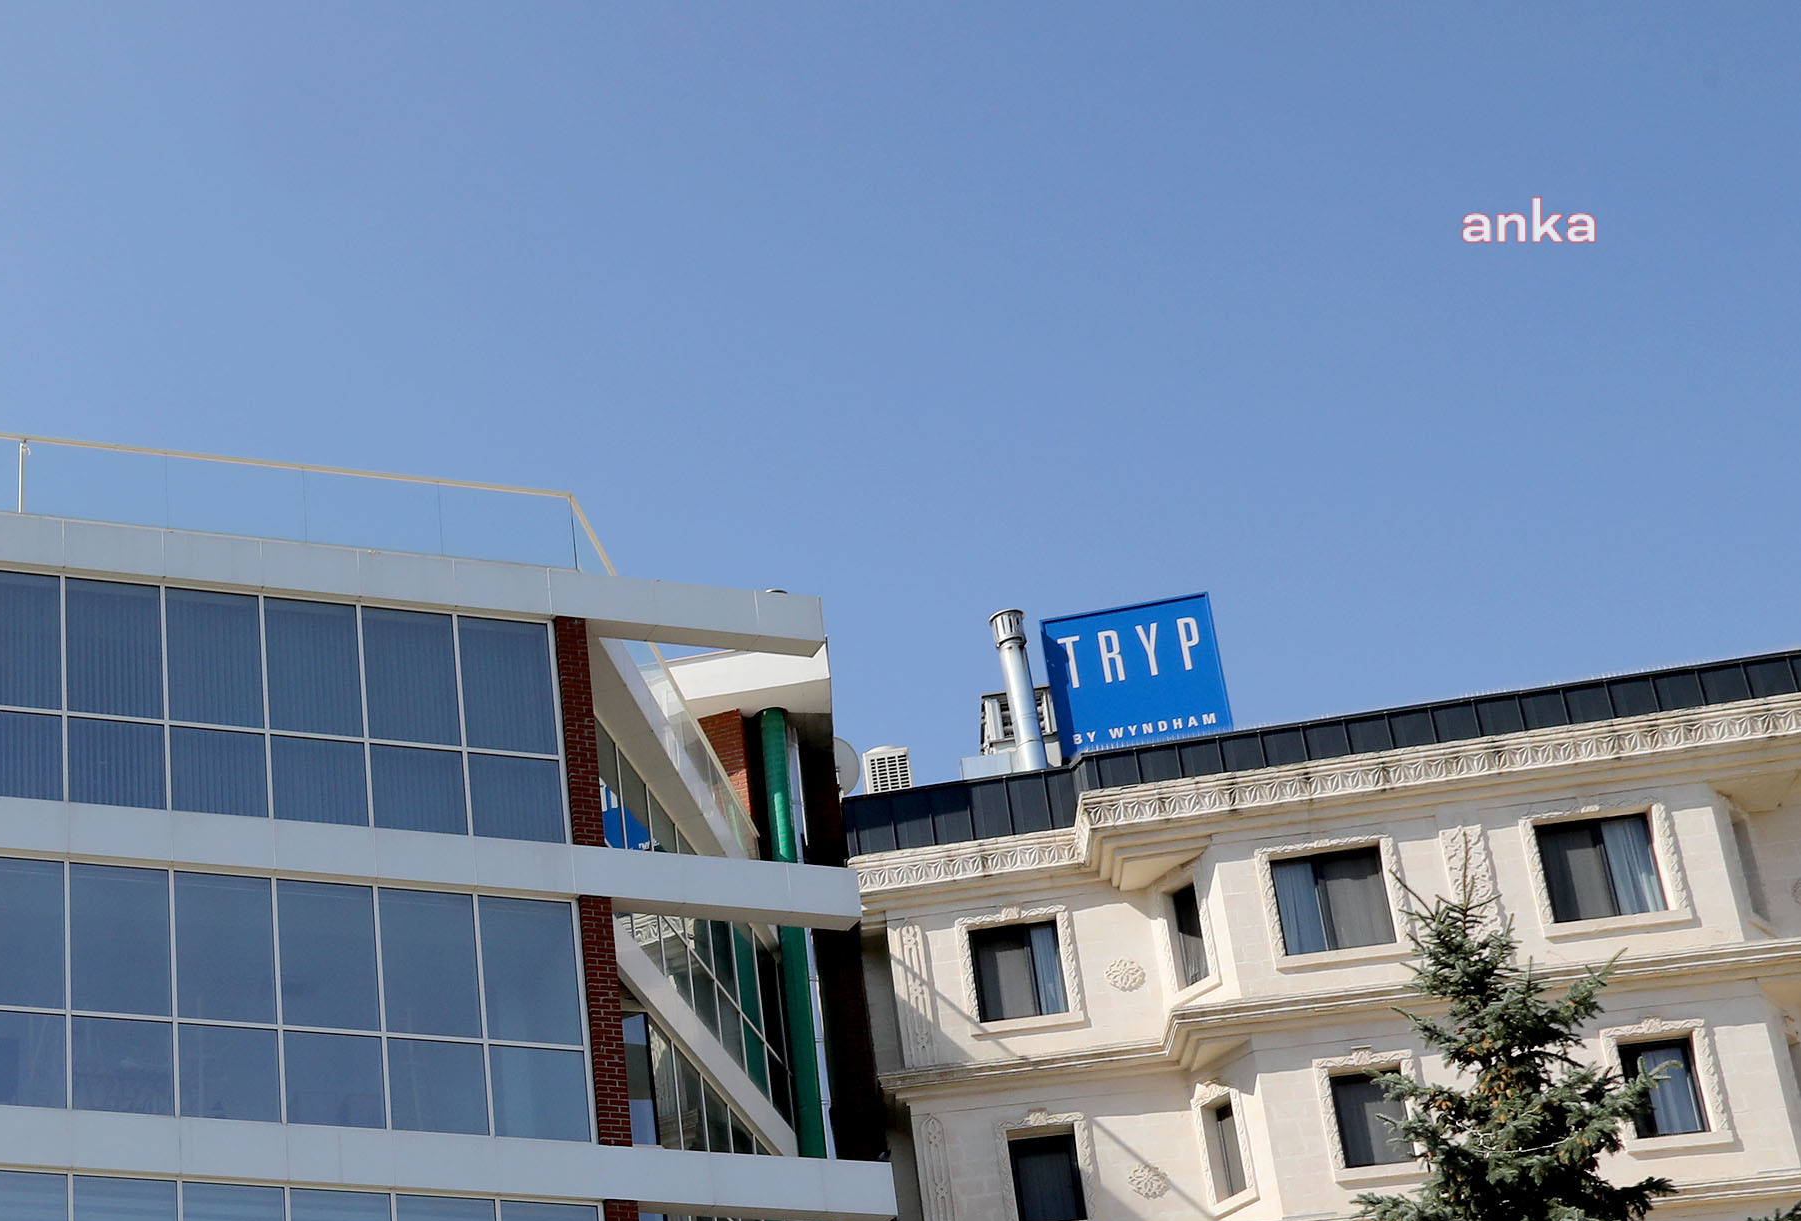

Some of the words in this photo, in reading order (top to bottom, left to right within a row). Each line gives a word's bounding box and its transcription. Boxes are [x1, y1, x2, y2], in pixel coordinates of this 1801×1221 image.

[1056, 616, 1200, 689] TRYP
[1072, 730, 1096, 745] BY
[1108, 712, 1218, 740] WYNDHAM
